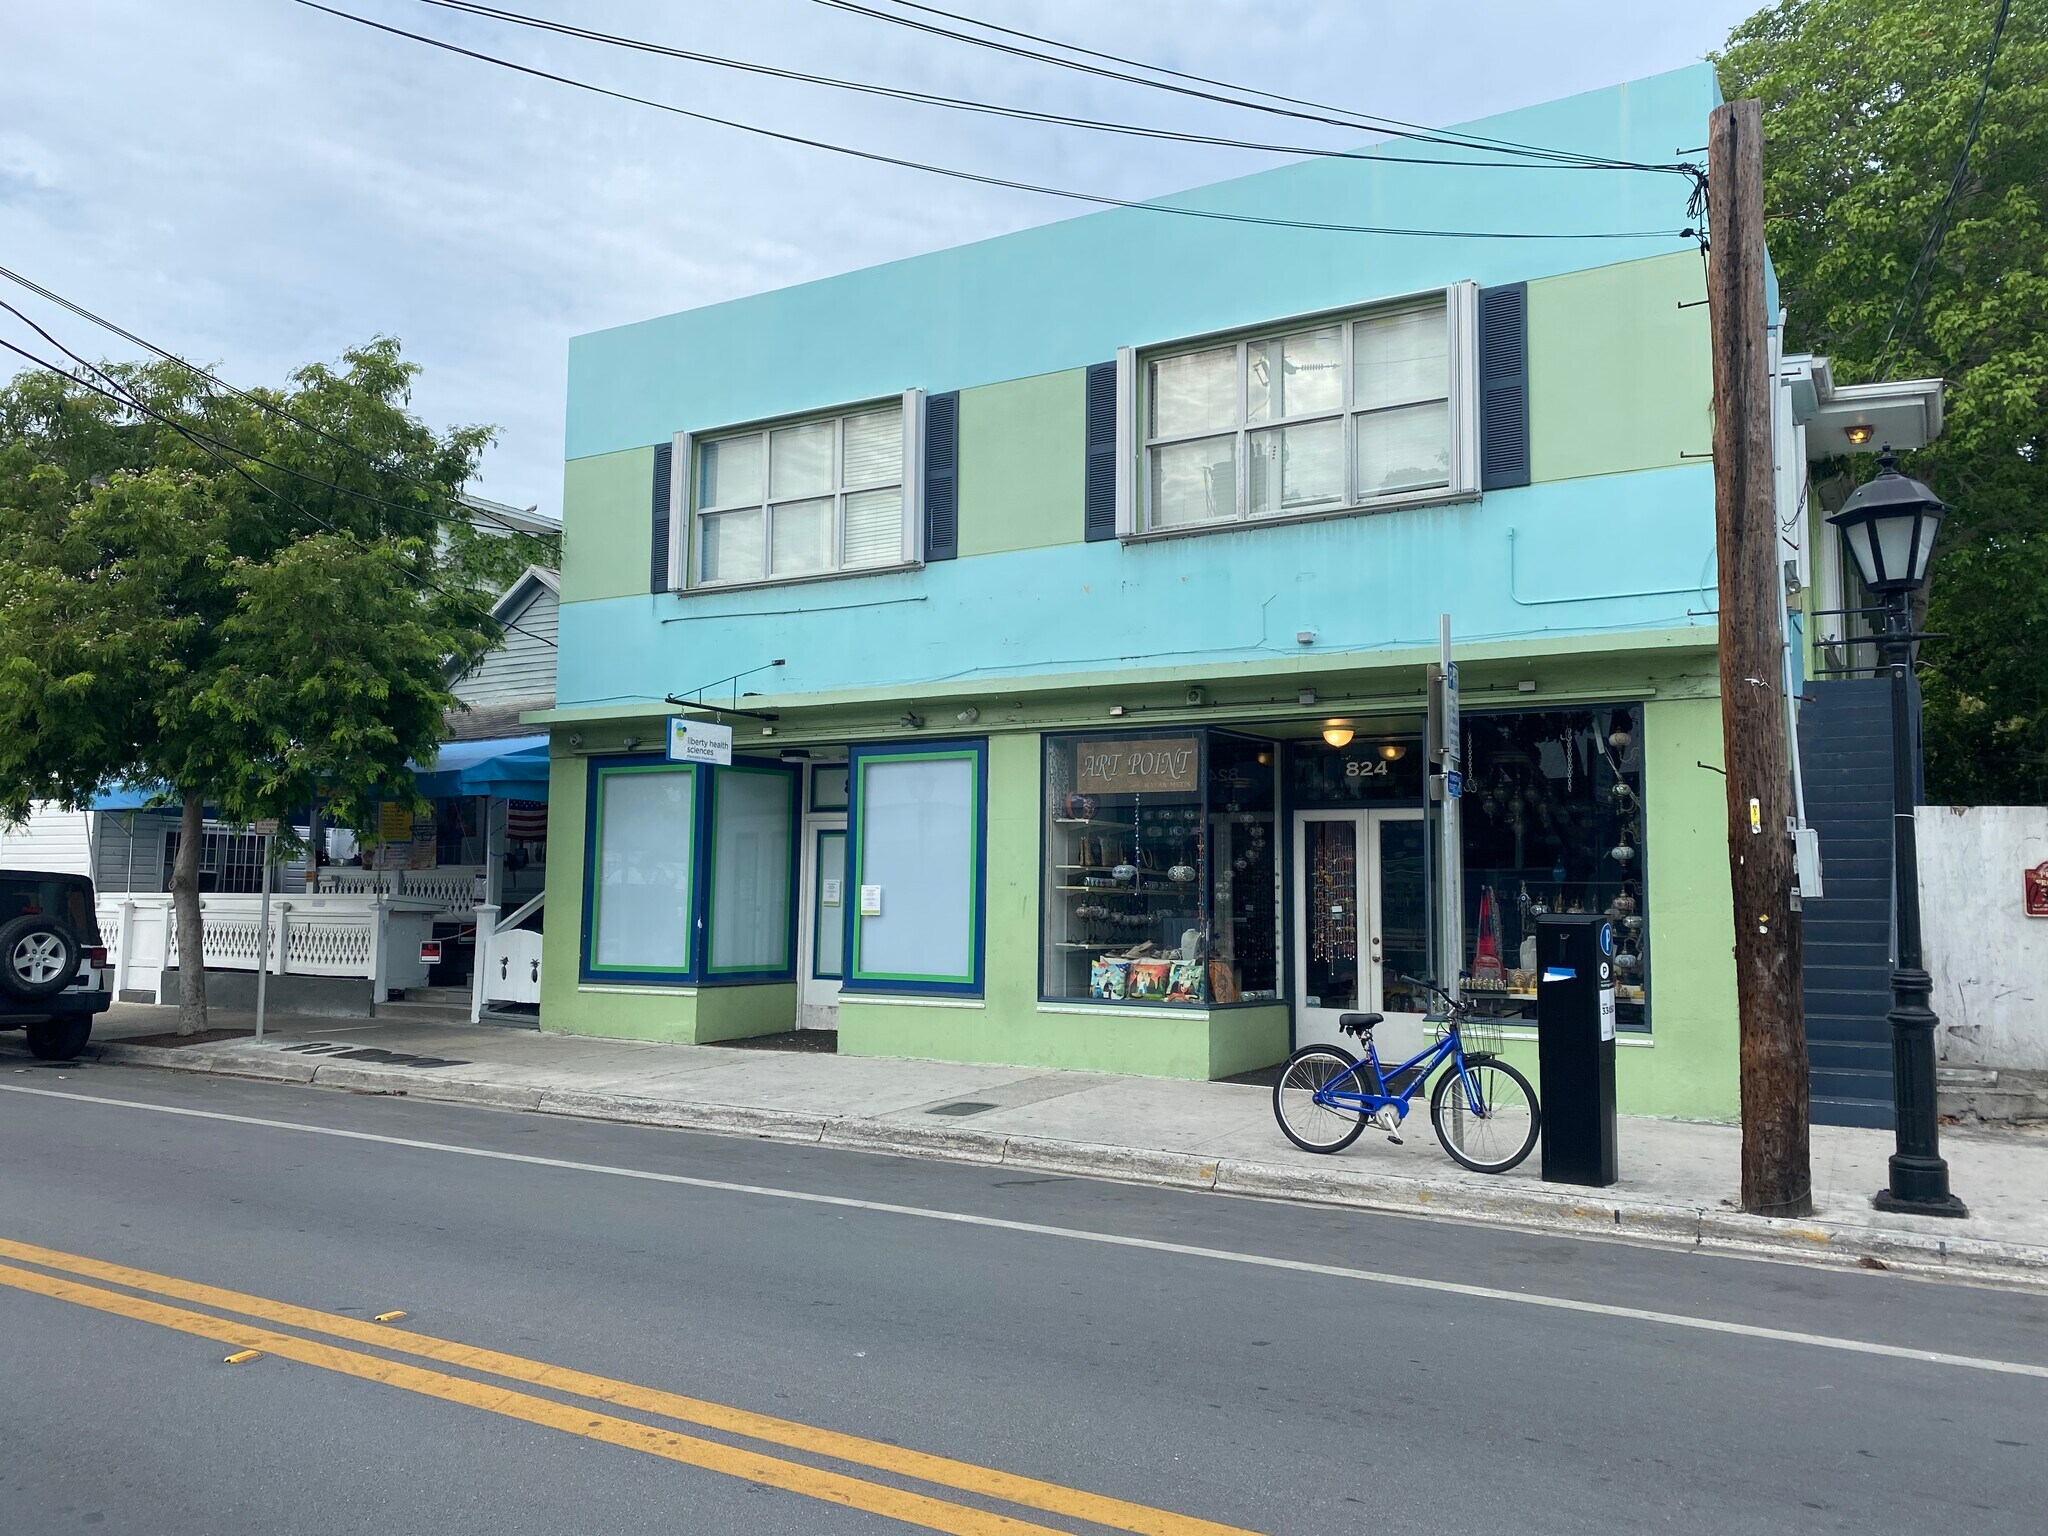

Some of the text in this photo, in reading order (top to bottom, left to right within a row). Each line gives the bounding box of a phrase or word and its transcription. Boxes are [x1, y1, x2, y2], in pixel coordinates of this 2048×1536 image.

[687, 737, 729, 750] liberty health
[686, 746, 714, 756] sciences
[1082, 748, 1193, 782] ART POINT
[1345, 760, 1388, 776] 824
